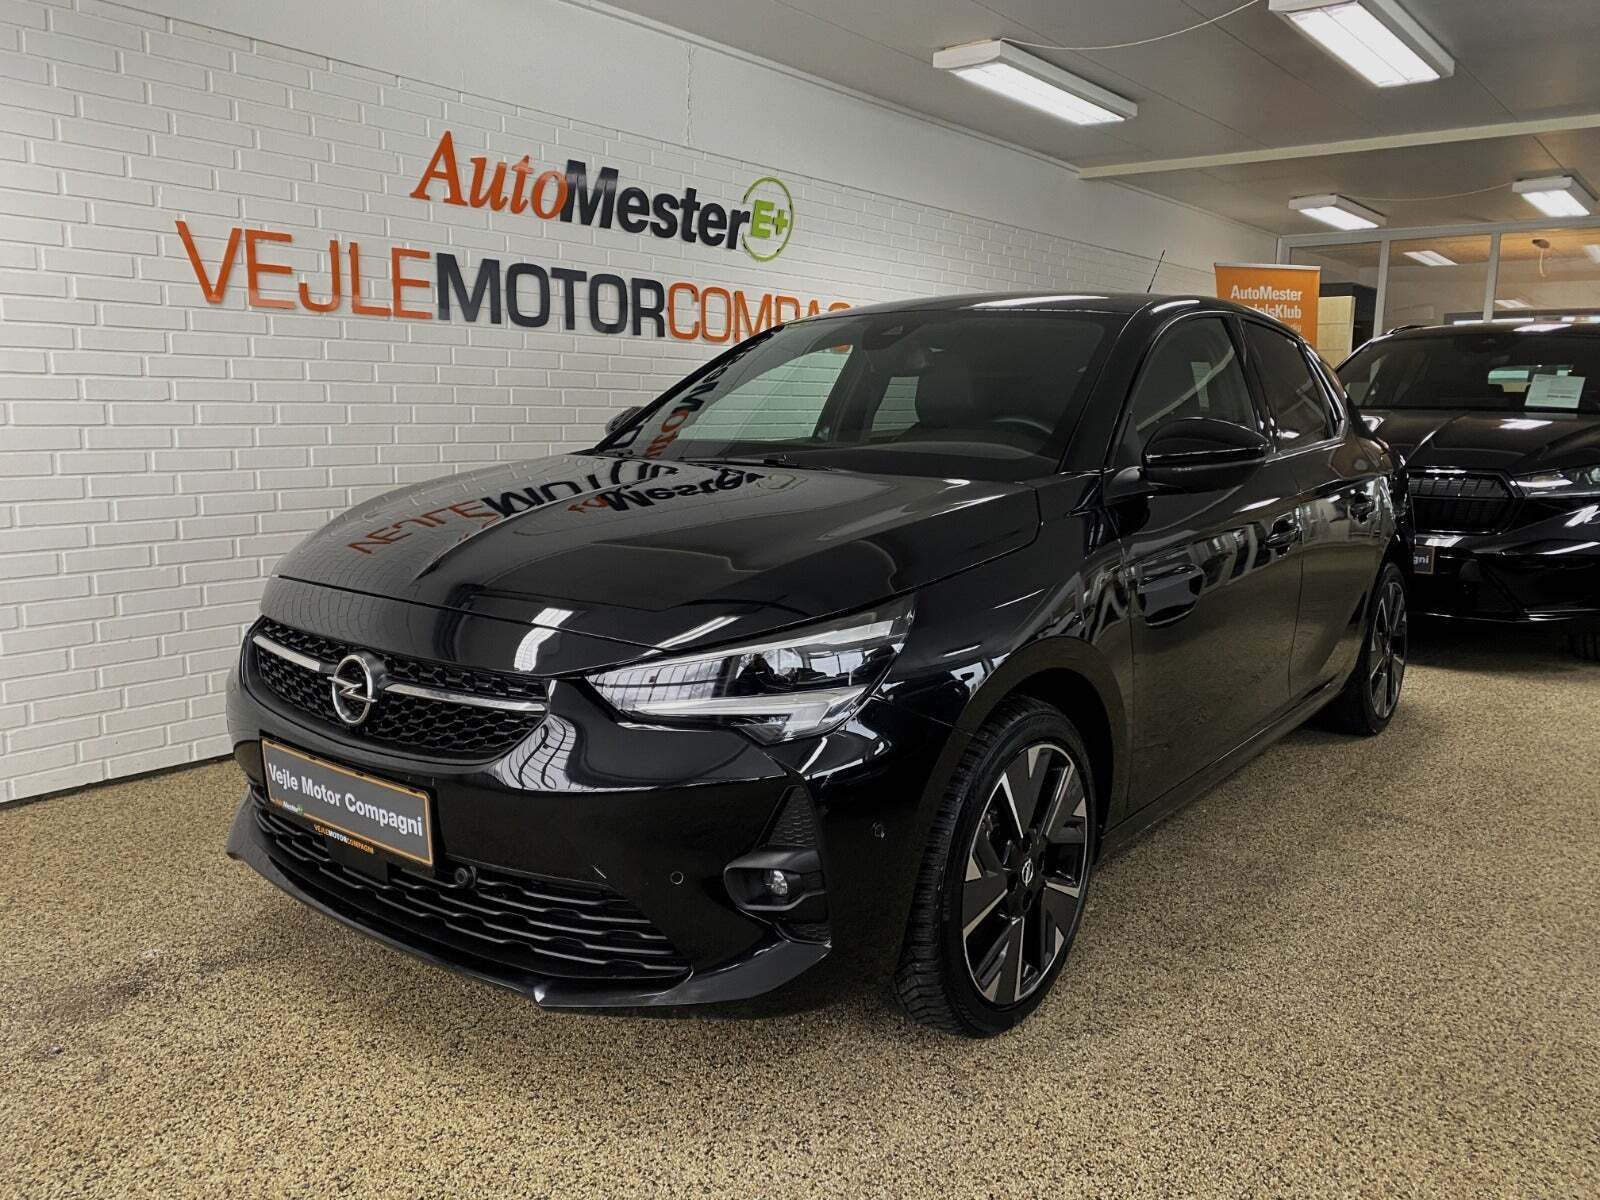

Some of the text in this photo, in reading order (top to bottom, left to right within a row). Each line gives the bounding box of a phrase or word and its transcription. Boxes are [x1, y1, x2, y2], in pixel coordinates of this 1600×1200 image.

[410, 130, 751, 250] AutoMester
[175, 220, 850, 343] VEJLEMOTORCOMP
[1230, 285, 1303, 302] AutoMester
[268, 763, 299, 791] Vejle
[301, 775, 342, 807] Motor
[344, 792, 423, 837] Compagni
